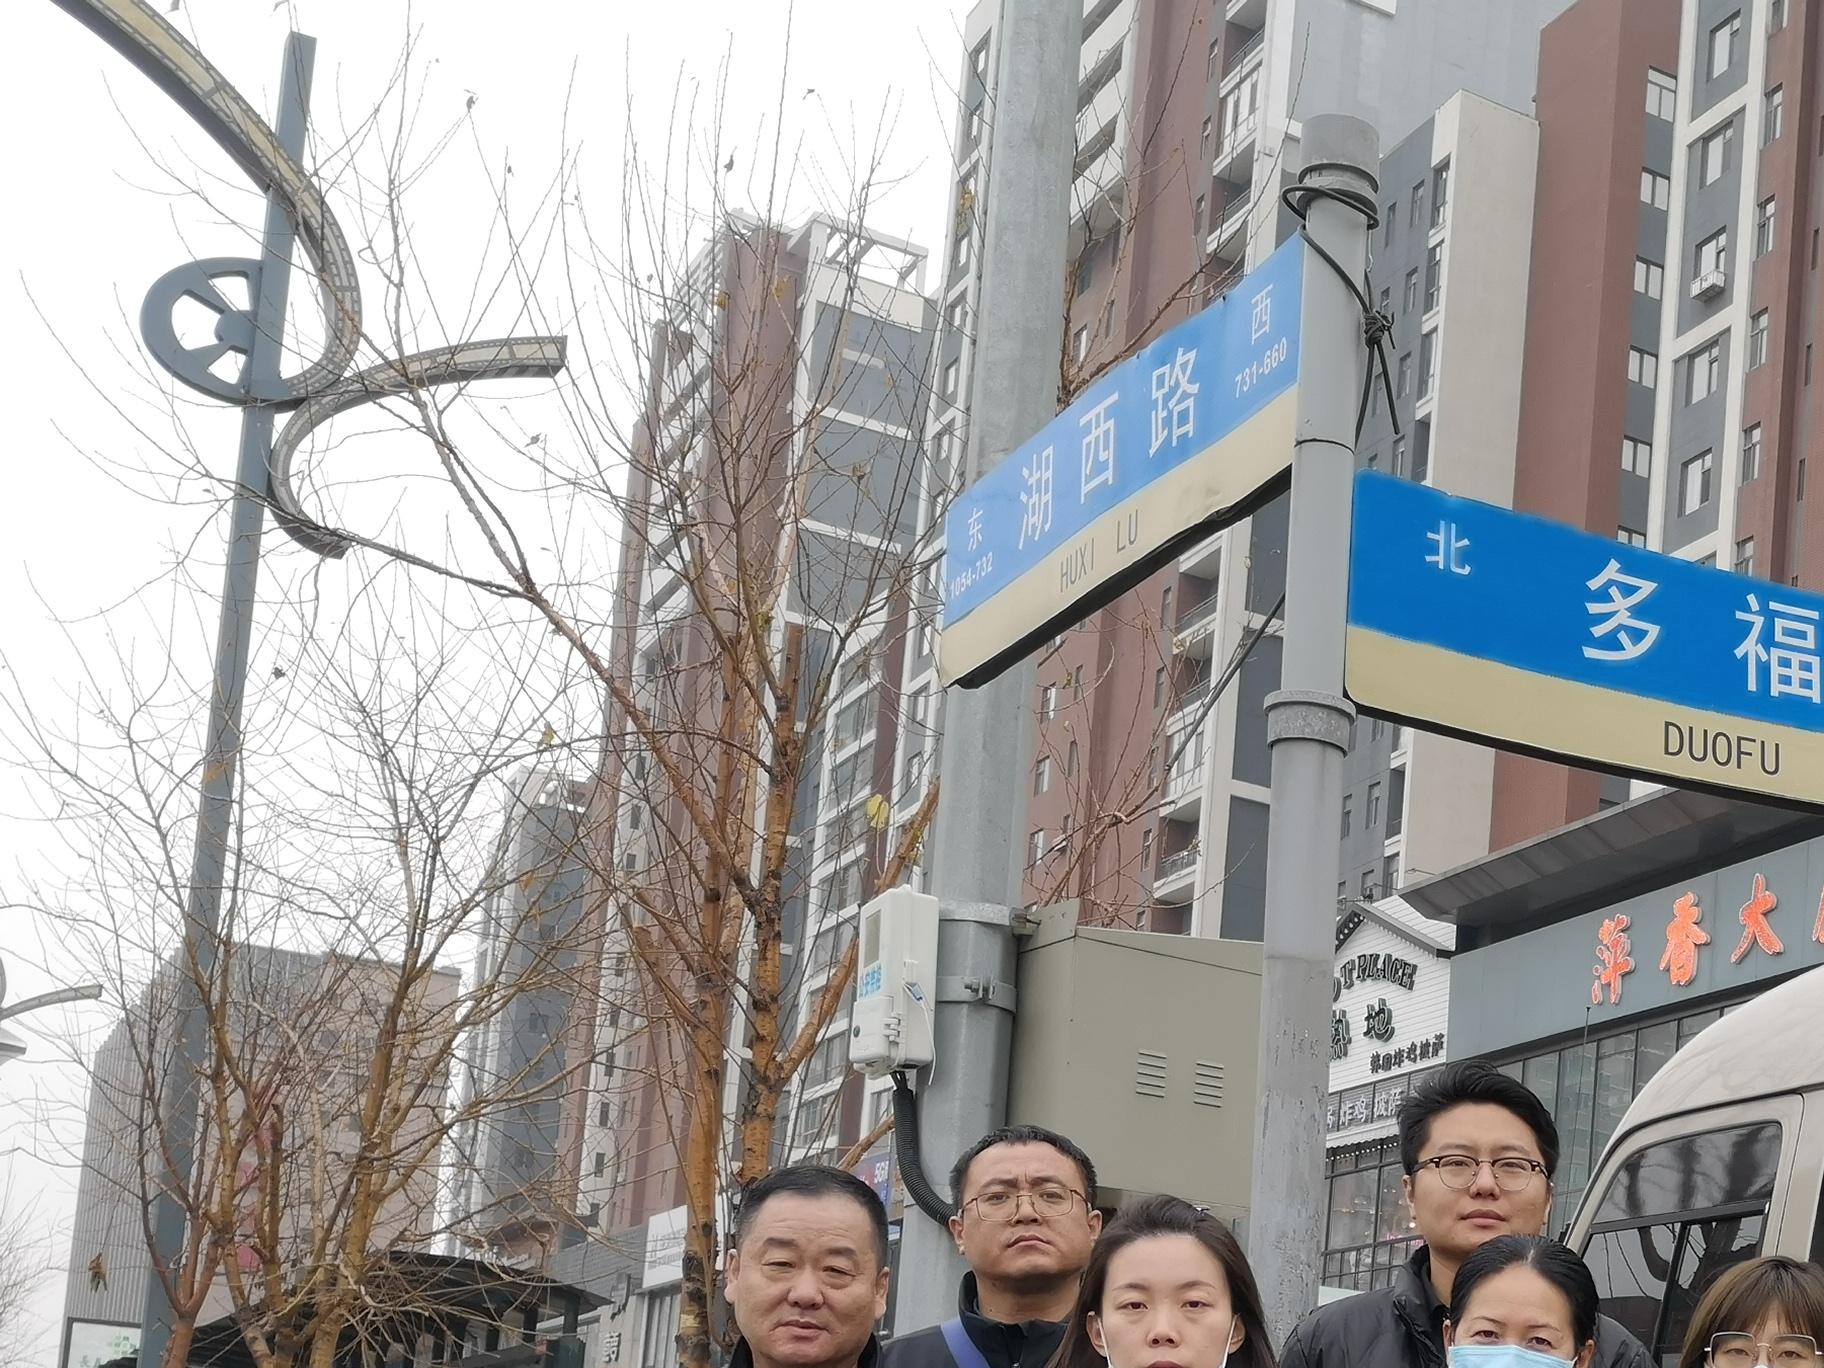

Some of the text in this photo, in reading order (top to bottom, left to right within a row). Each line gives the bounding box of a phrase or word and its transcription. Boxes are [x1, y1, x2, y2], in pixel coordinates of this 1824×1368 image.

[1234, 337, 1288, 399] 731-660
[967, 284, 1274, 552] 东 湖西路 西
[1059, 509, 1139, 594] HUXI LU
[1424, 520, 1472, 576] 北
[949, 556, 995, 600] 1054-732
[1663, 721, 1781, 776] DUOFU
[1356, 953, 1418, 991] PLACE
